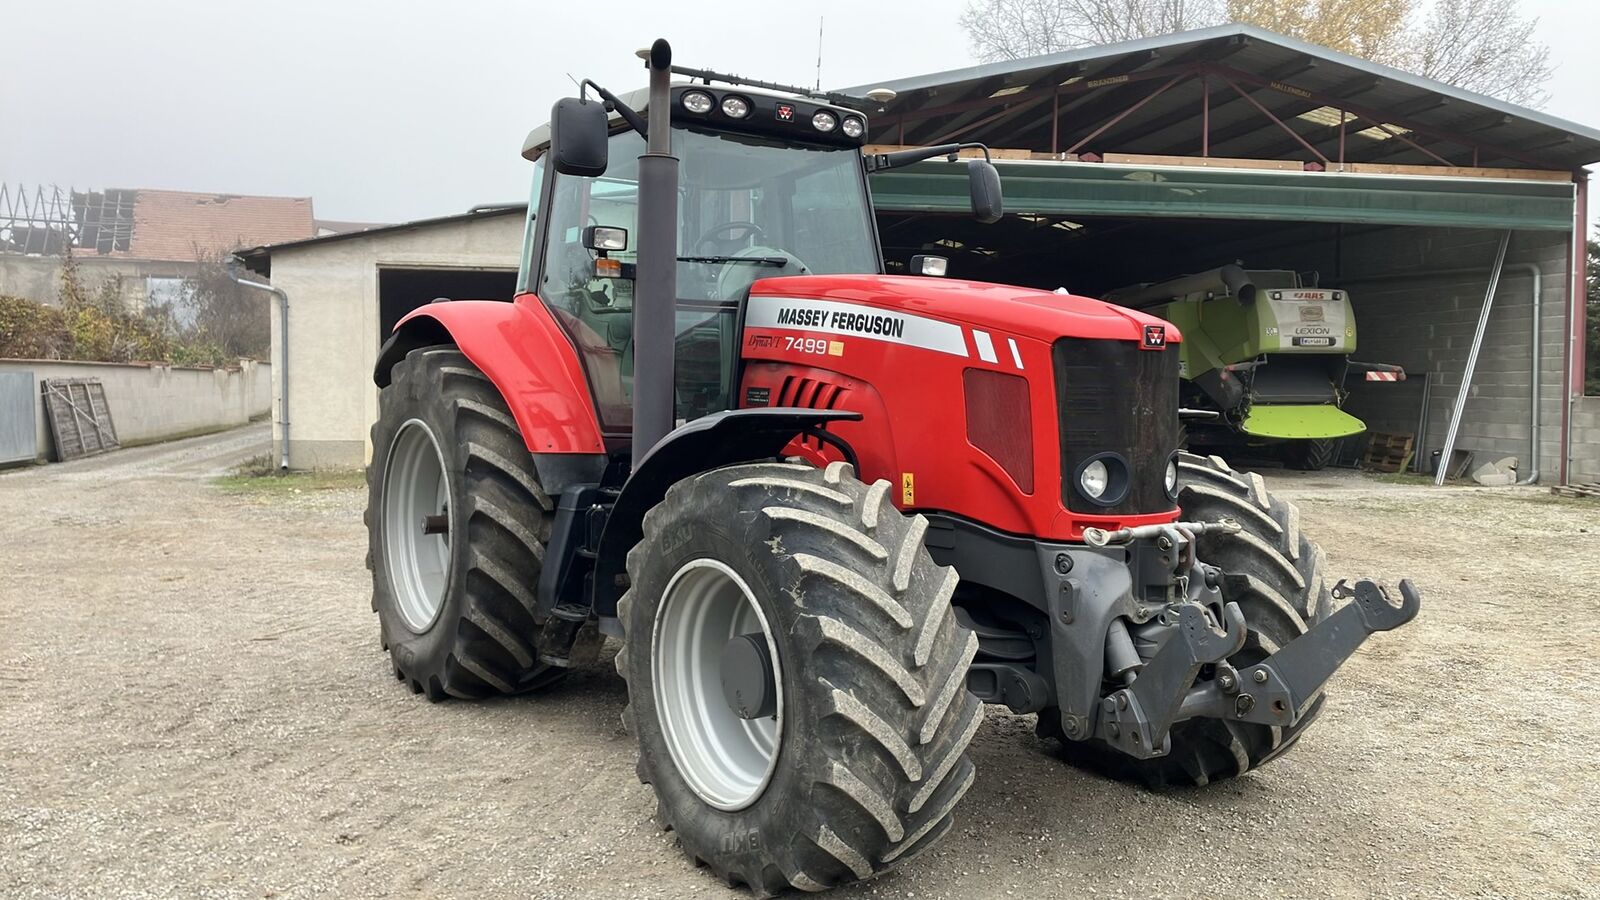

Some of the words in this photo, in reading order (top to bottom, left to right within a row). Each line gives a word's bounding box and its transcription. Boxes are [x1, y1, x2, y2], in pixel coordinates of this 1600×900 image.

[1294, 292, 1326, 300] CLAAS
[777, 307, 830, 328] MASSEY
[830, 311, 904, 338] FERGUSON
[1295, 327, 1330, 335] LEXION
[784, 336, 827, 355] 7499
